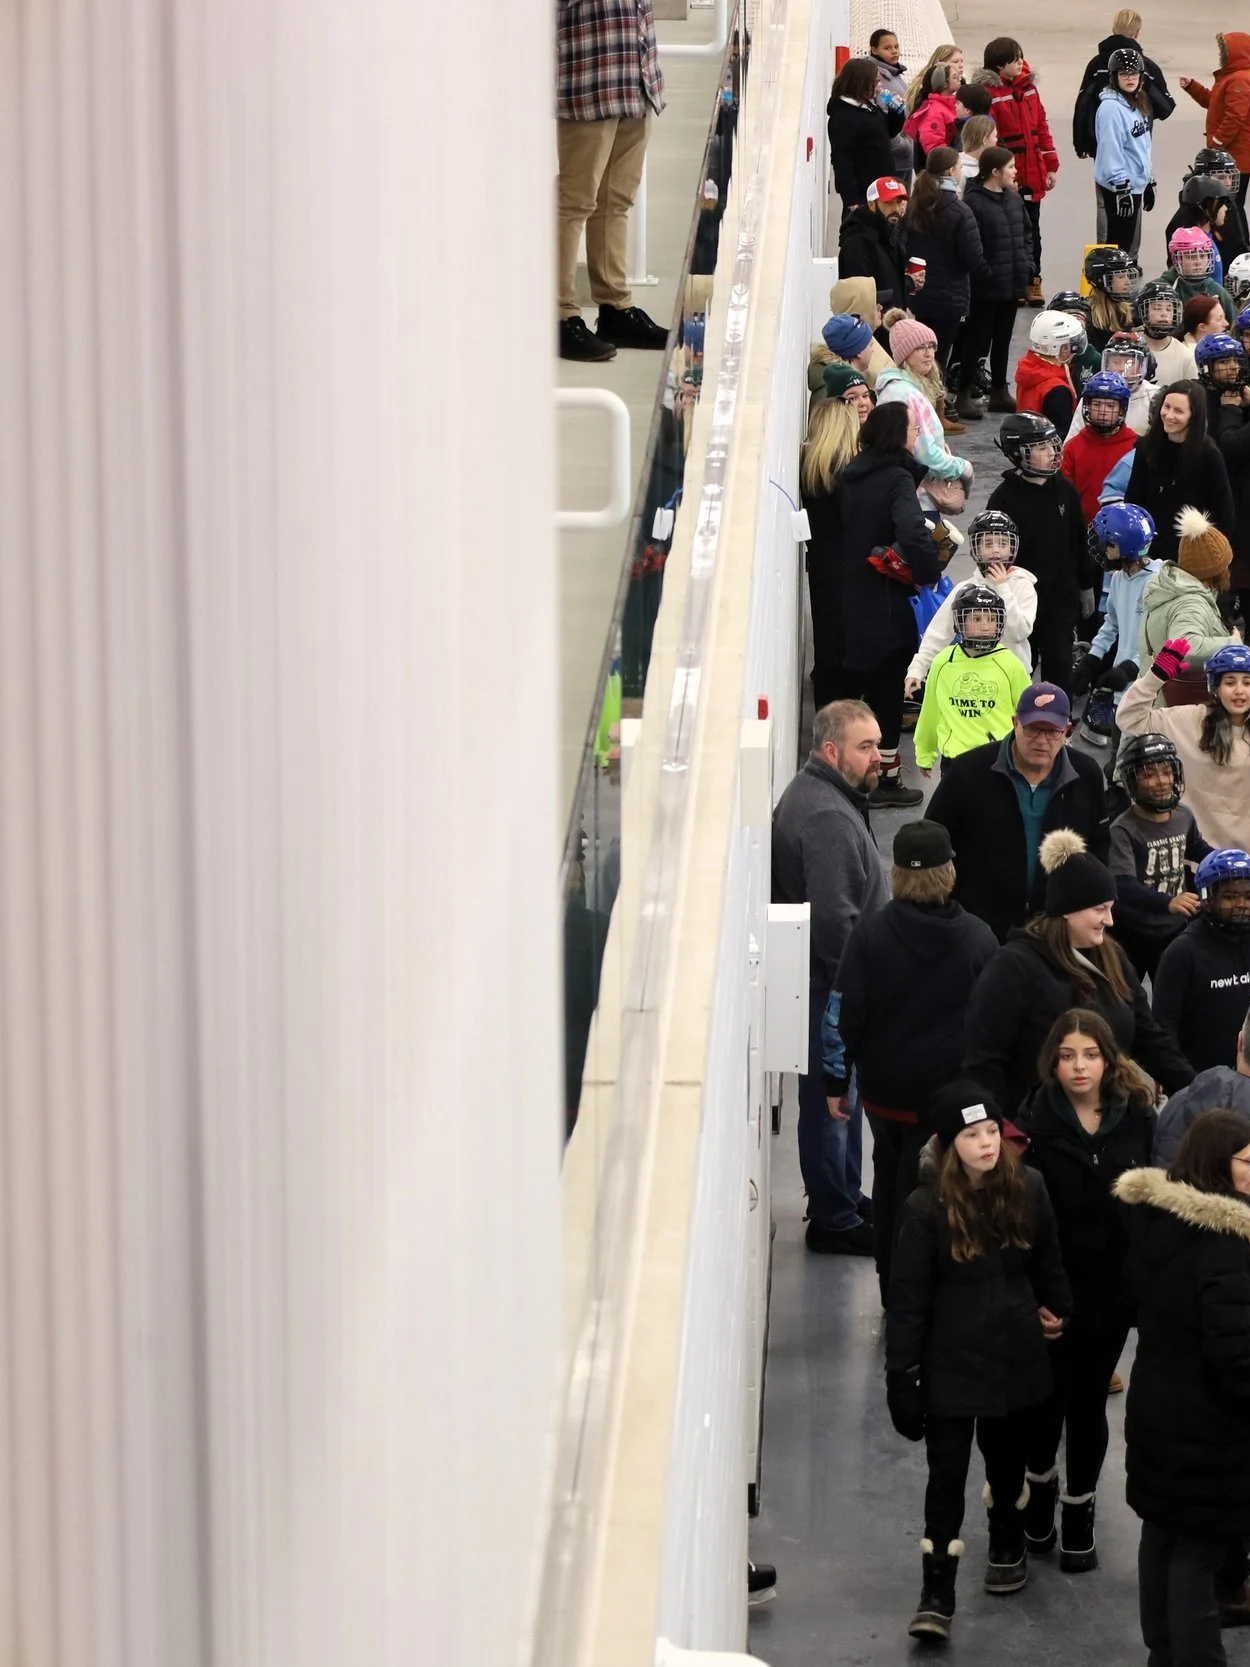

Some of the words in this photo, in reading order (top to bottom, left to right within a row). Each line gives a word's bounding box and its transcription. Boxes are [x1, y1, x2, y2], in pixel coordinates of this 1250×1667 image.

[949, 697, 978, 708] TIME
[980, 699, 996, 709] TO
[958, 708, 982, 718] WIN
[1210, 977, 1233, 989] new
